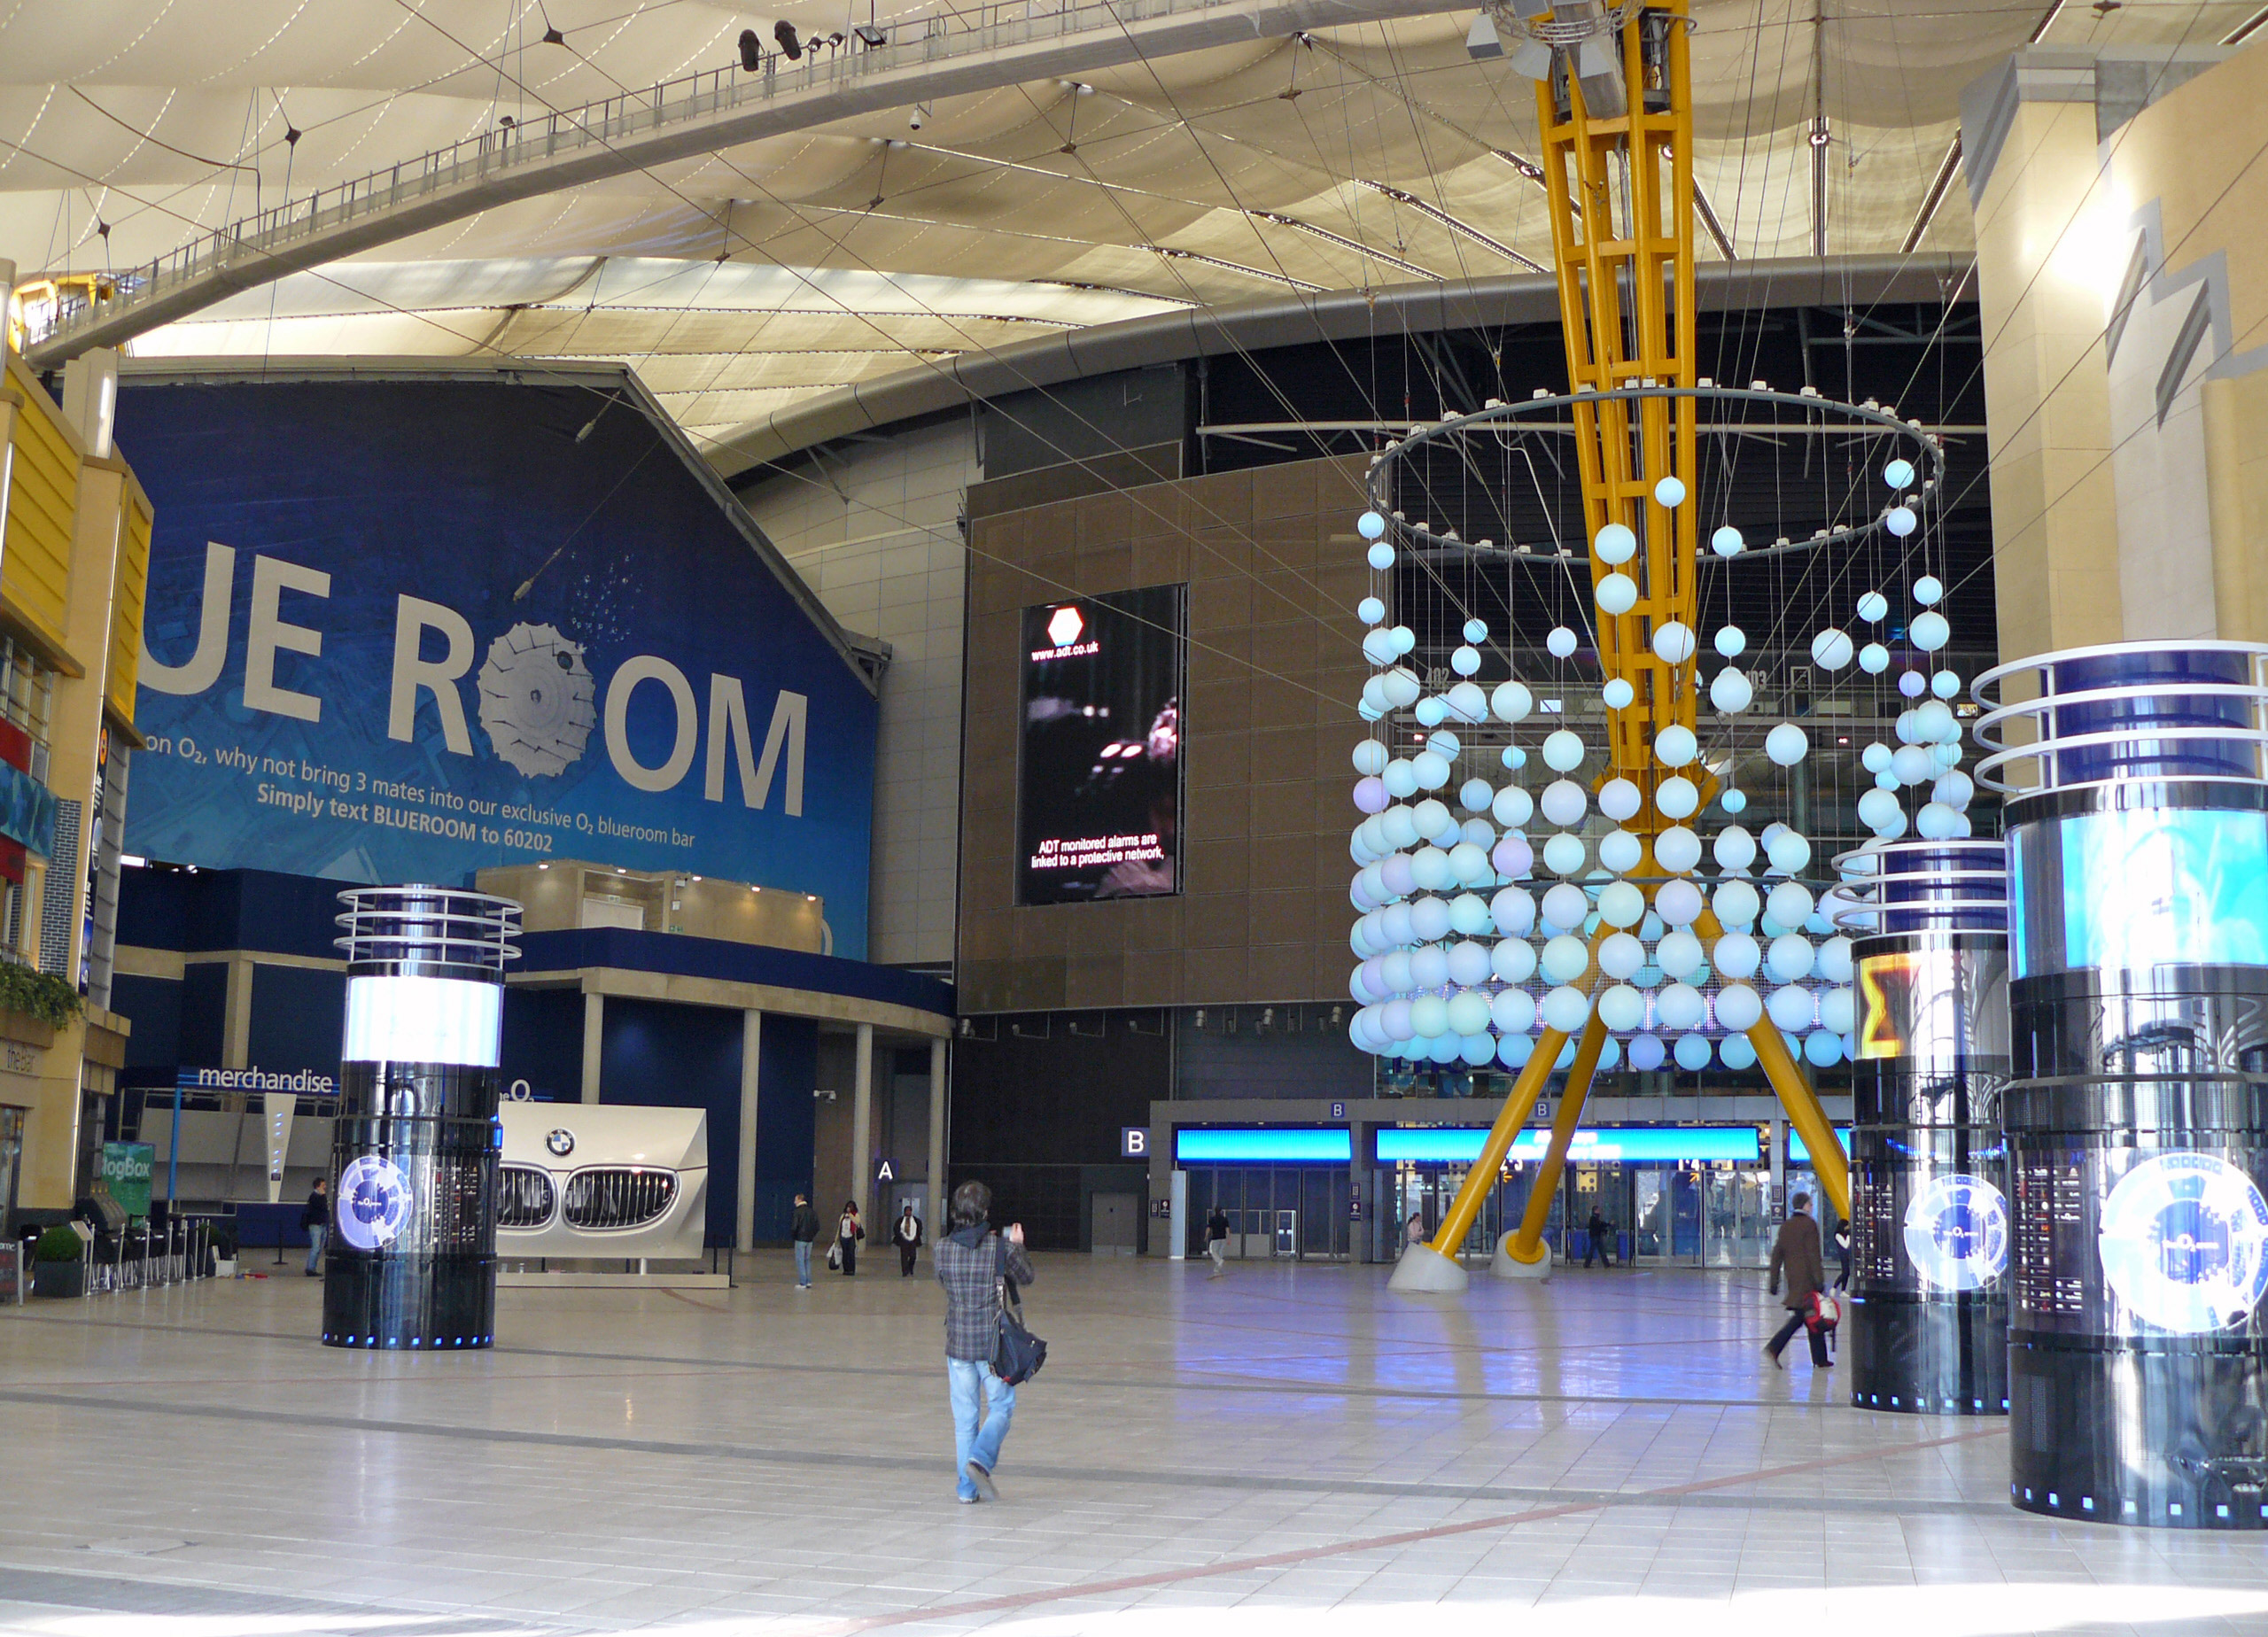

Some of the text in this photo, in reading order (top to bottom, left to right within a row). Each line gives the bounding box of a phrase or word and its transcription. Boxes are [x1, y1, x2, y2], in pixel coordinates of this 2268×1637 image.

[1031, 640, 1099, 662] www.adt.co.uk
[145, 736, 172, 754] on
[215, 747, 258, 775] why
[263, 757, 296, 779] not
[301, 760, 350, 794] bring
[356, 772, 367, 792] 3
[372, 780, 425, 803] mates
[430, 787, 464, 811] into
[469, 799, 498, 816] our
[501, 803, 571, 828] exclusive
[598, 816, 668, 843] blueroom
[672, 827, 695, 848] bar
[257, 783, 553, 853] Simply text BLUEROOM to 60202
[1038, 834, 1157, 855] ADT monitored alarms are
[1031, 855, 1058, 869] linked
[1060, 854, 1068, 867] to
[1070, 855, 1077, 866] a
[1078, 849, 1123, 868] protective
[198, 1066, 333, 1093] merchandise
[1333, 1104, 1342, 1117] B
[1537, 1103, 1547, 1116] B
[1128, 1130, 1145, 1153] B
[878, 1160, 894, 1180] A
